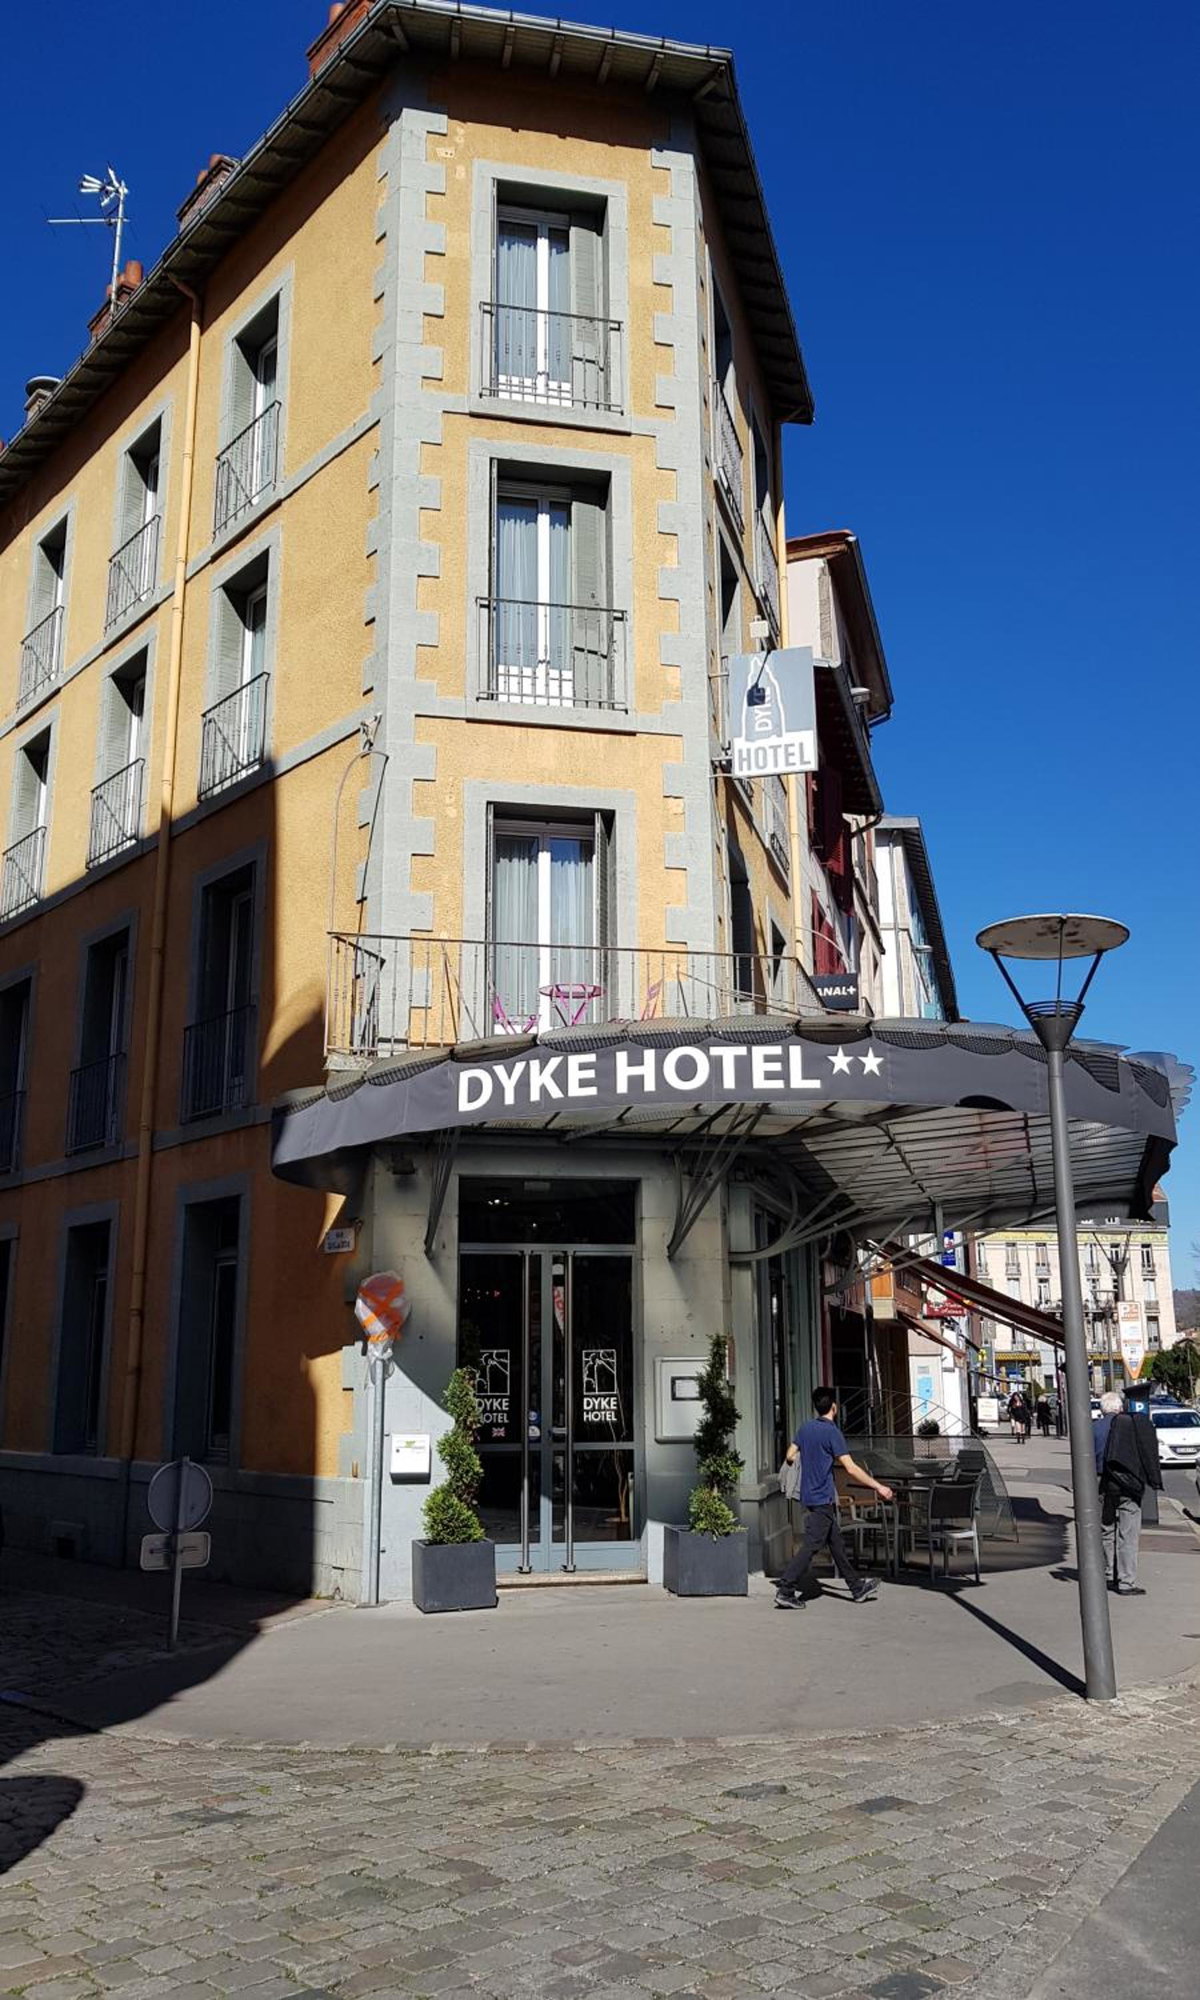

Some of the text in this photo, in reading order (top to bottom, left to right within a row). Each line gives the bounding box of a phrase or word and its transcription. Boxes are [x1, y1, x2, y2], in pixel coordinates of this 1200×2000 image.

[738, 742, 811, 771] HOTEL
[816, 985, 857, 996] ANAL+
[457, 1045, 821, 1112] DYKE HOTEL
[475, 1398, 510, 1411] DYKE
[583, 1397, 617, 1410] DYKE
[1135, 1402, 1144, 1412] P
[583, 1411, 617, 1422] HOTEL
